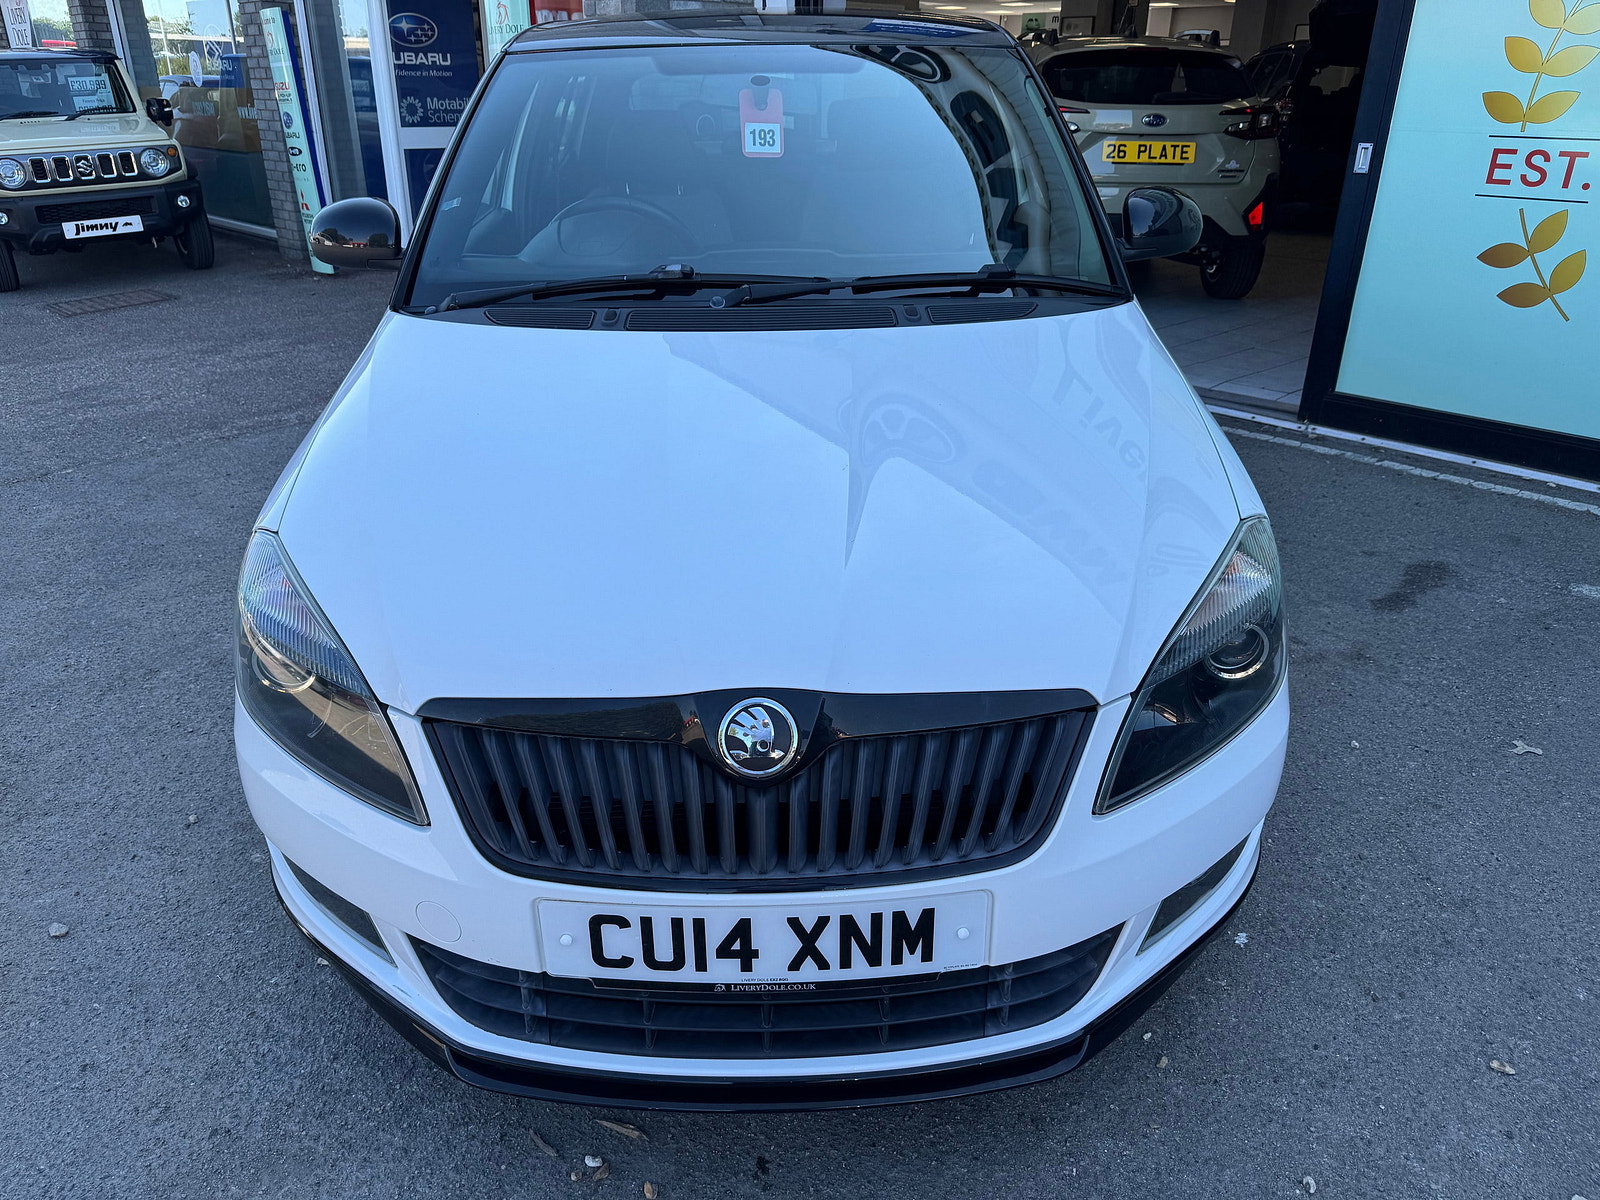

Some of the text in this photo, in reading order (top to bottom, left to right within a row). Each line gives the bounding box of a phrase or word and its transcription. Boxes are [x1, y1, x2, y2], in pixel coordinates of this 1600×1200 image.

[12, 27, 31, 46] DOLE
[392, 51, 452, 66] UBARU
[395, 69, 422, 78] fidence
[426, 97, 471, 111] Motabil
[427, 110, 462, 123] Schem
[749, 128, 776, 147] 193
[1106, 143, 1191, 160] 26 PLATE
[1485, 147, 1592, 191] EST.
[74, 221, 119, 236] Jimny
[588, 907, 936, 974] CU14 XNM
